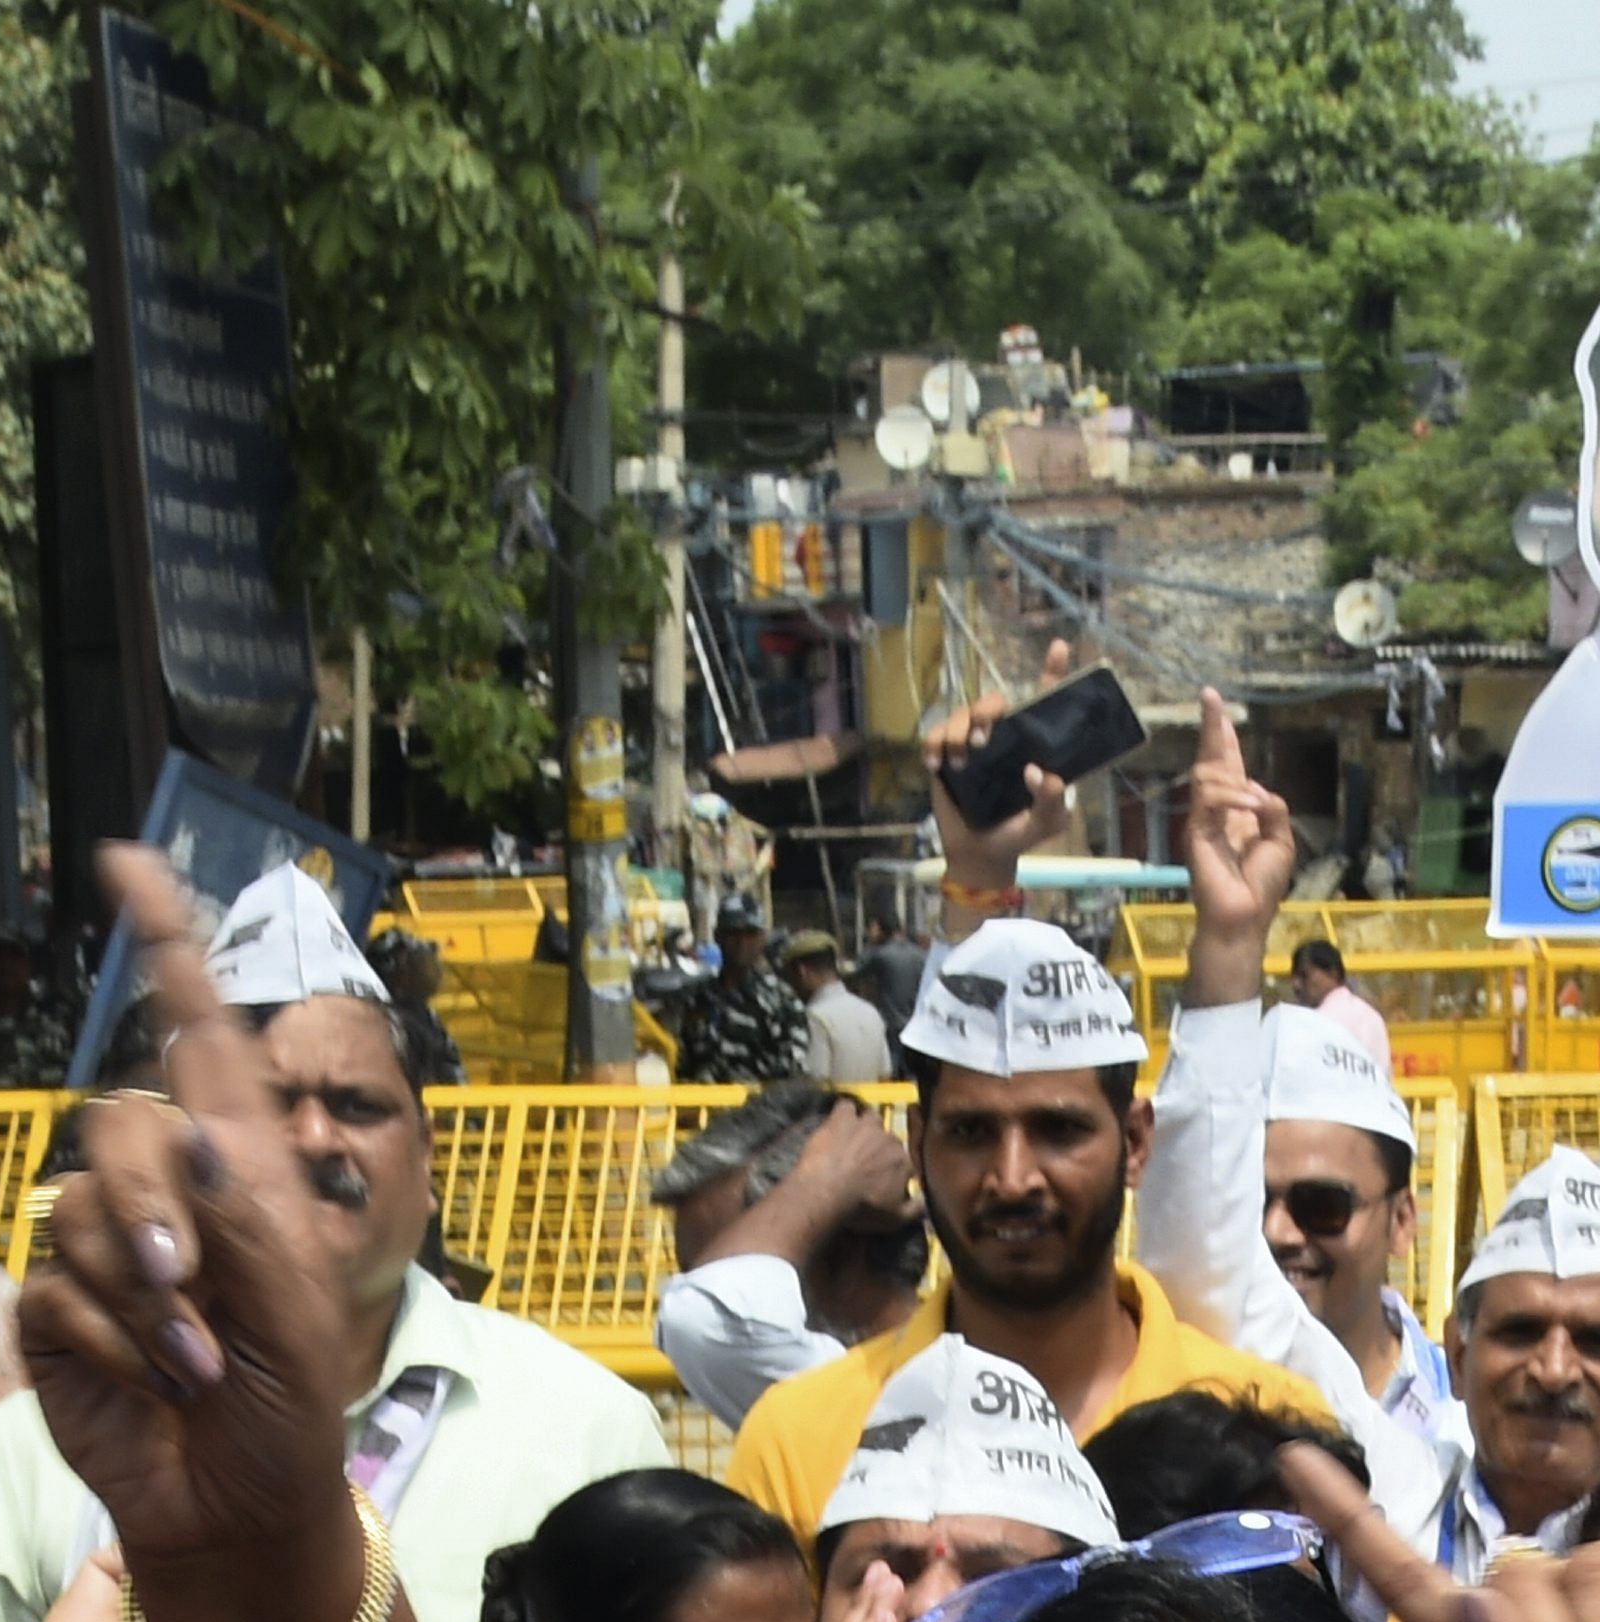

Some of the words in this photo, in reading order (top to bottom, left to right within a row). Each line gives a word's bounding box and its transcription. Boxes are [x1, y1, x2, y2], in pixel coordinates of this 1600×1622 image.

[1022, 959, 1093, 1000] आम
[970, 1369, 1065, 1440] आम
[980, 1446, 1052, 1478] चुनाव
